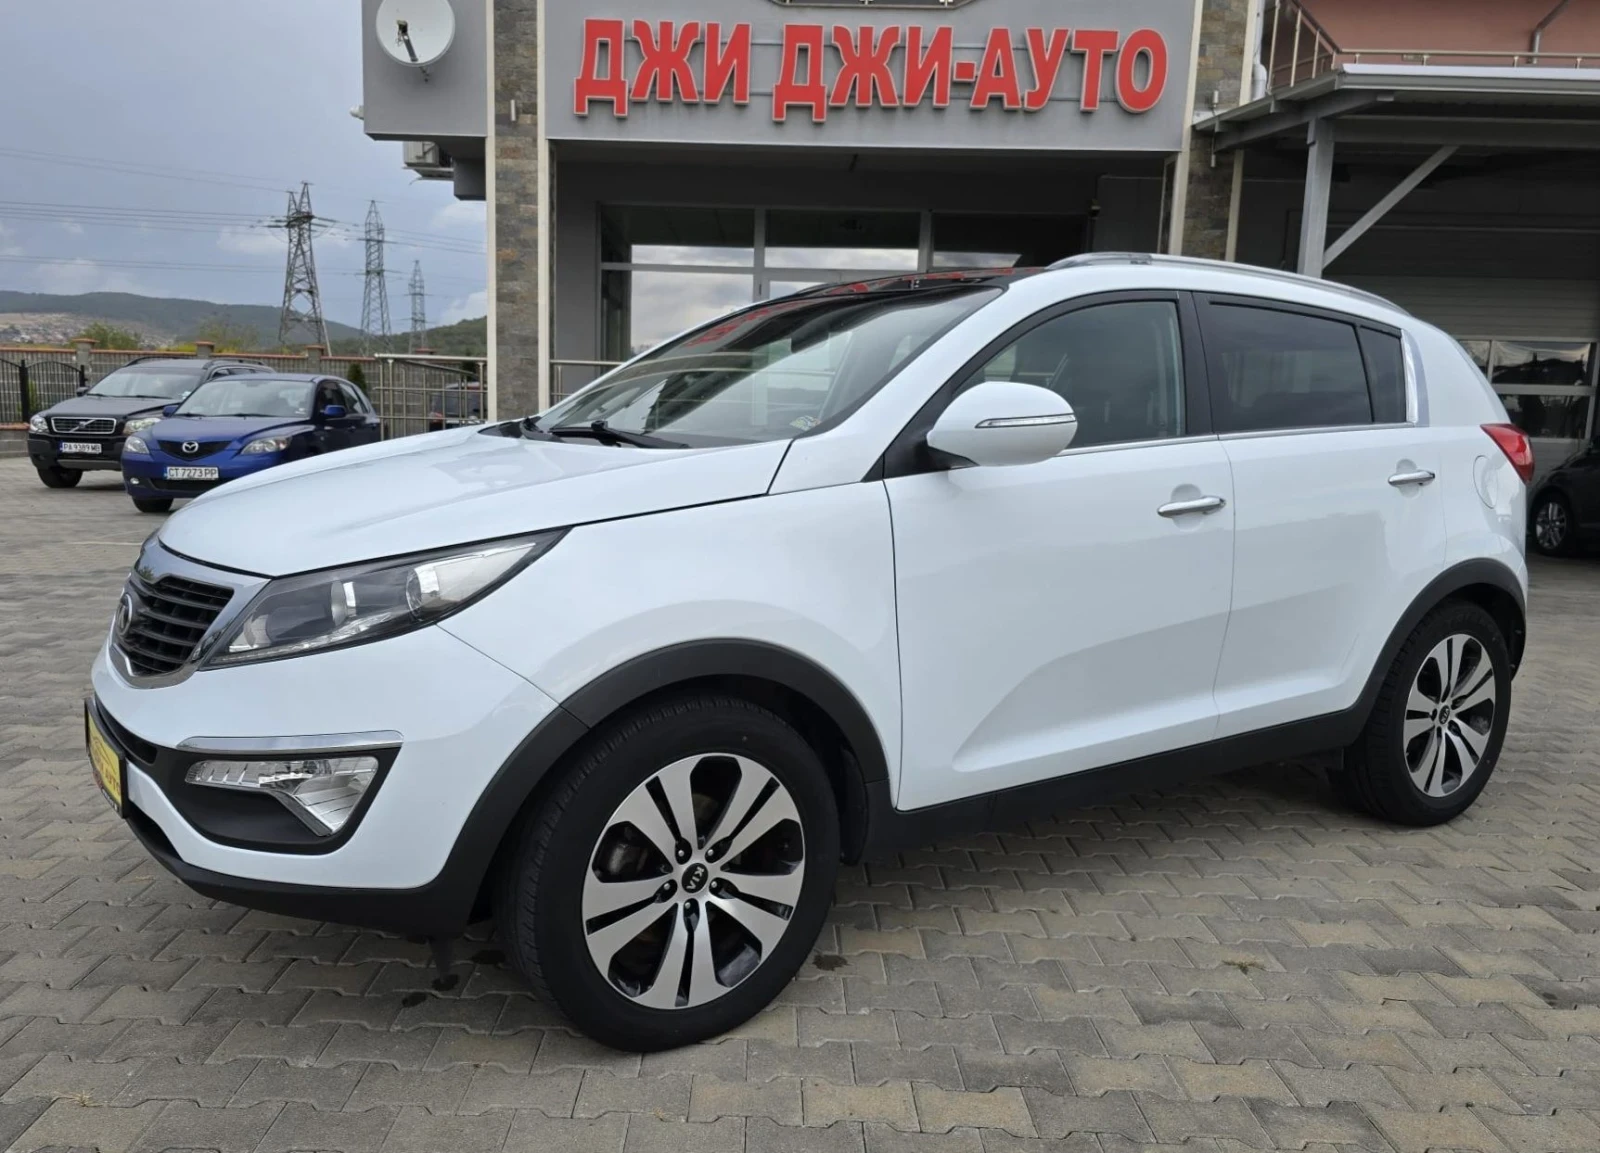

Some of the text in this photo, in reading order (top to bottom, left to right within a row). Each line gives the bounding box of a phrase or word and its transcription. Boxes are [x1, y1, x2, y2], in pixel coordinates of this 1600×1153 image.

[574, 19, 1168, 123] ДЖИ ДЖИ-АУТО
[168, 468, 217, 477] CT 7273 PP
[686, 866, 705, 889] KIA
